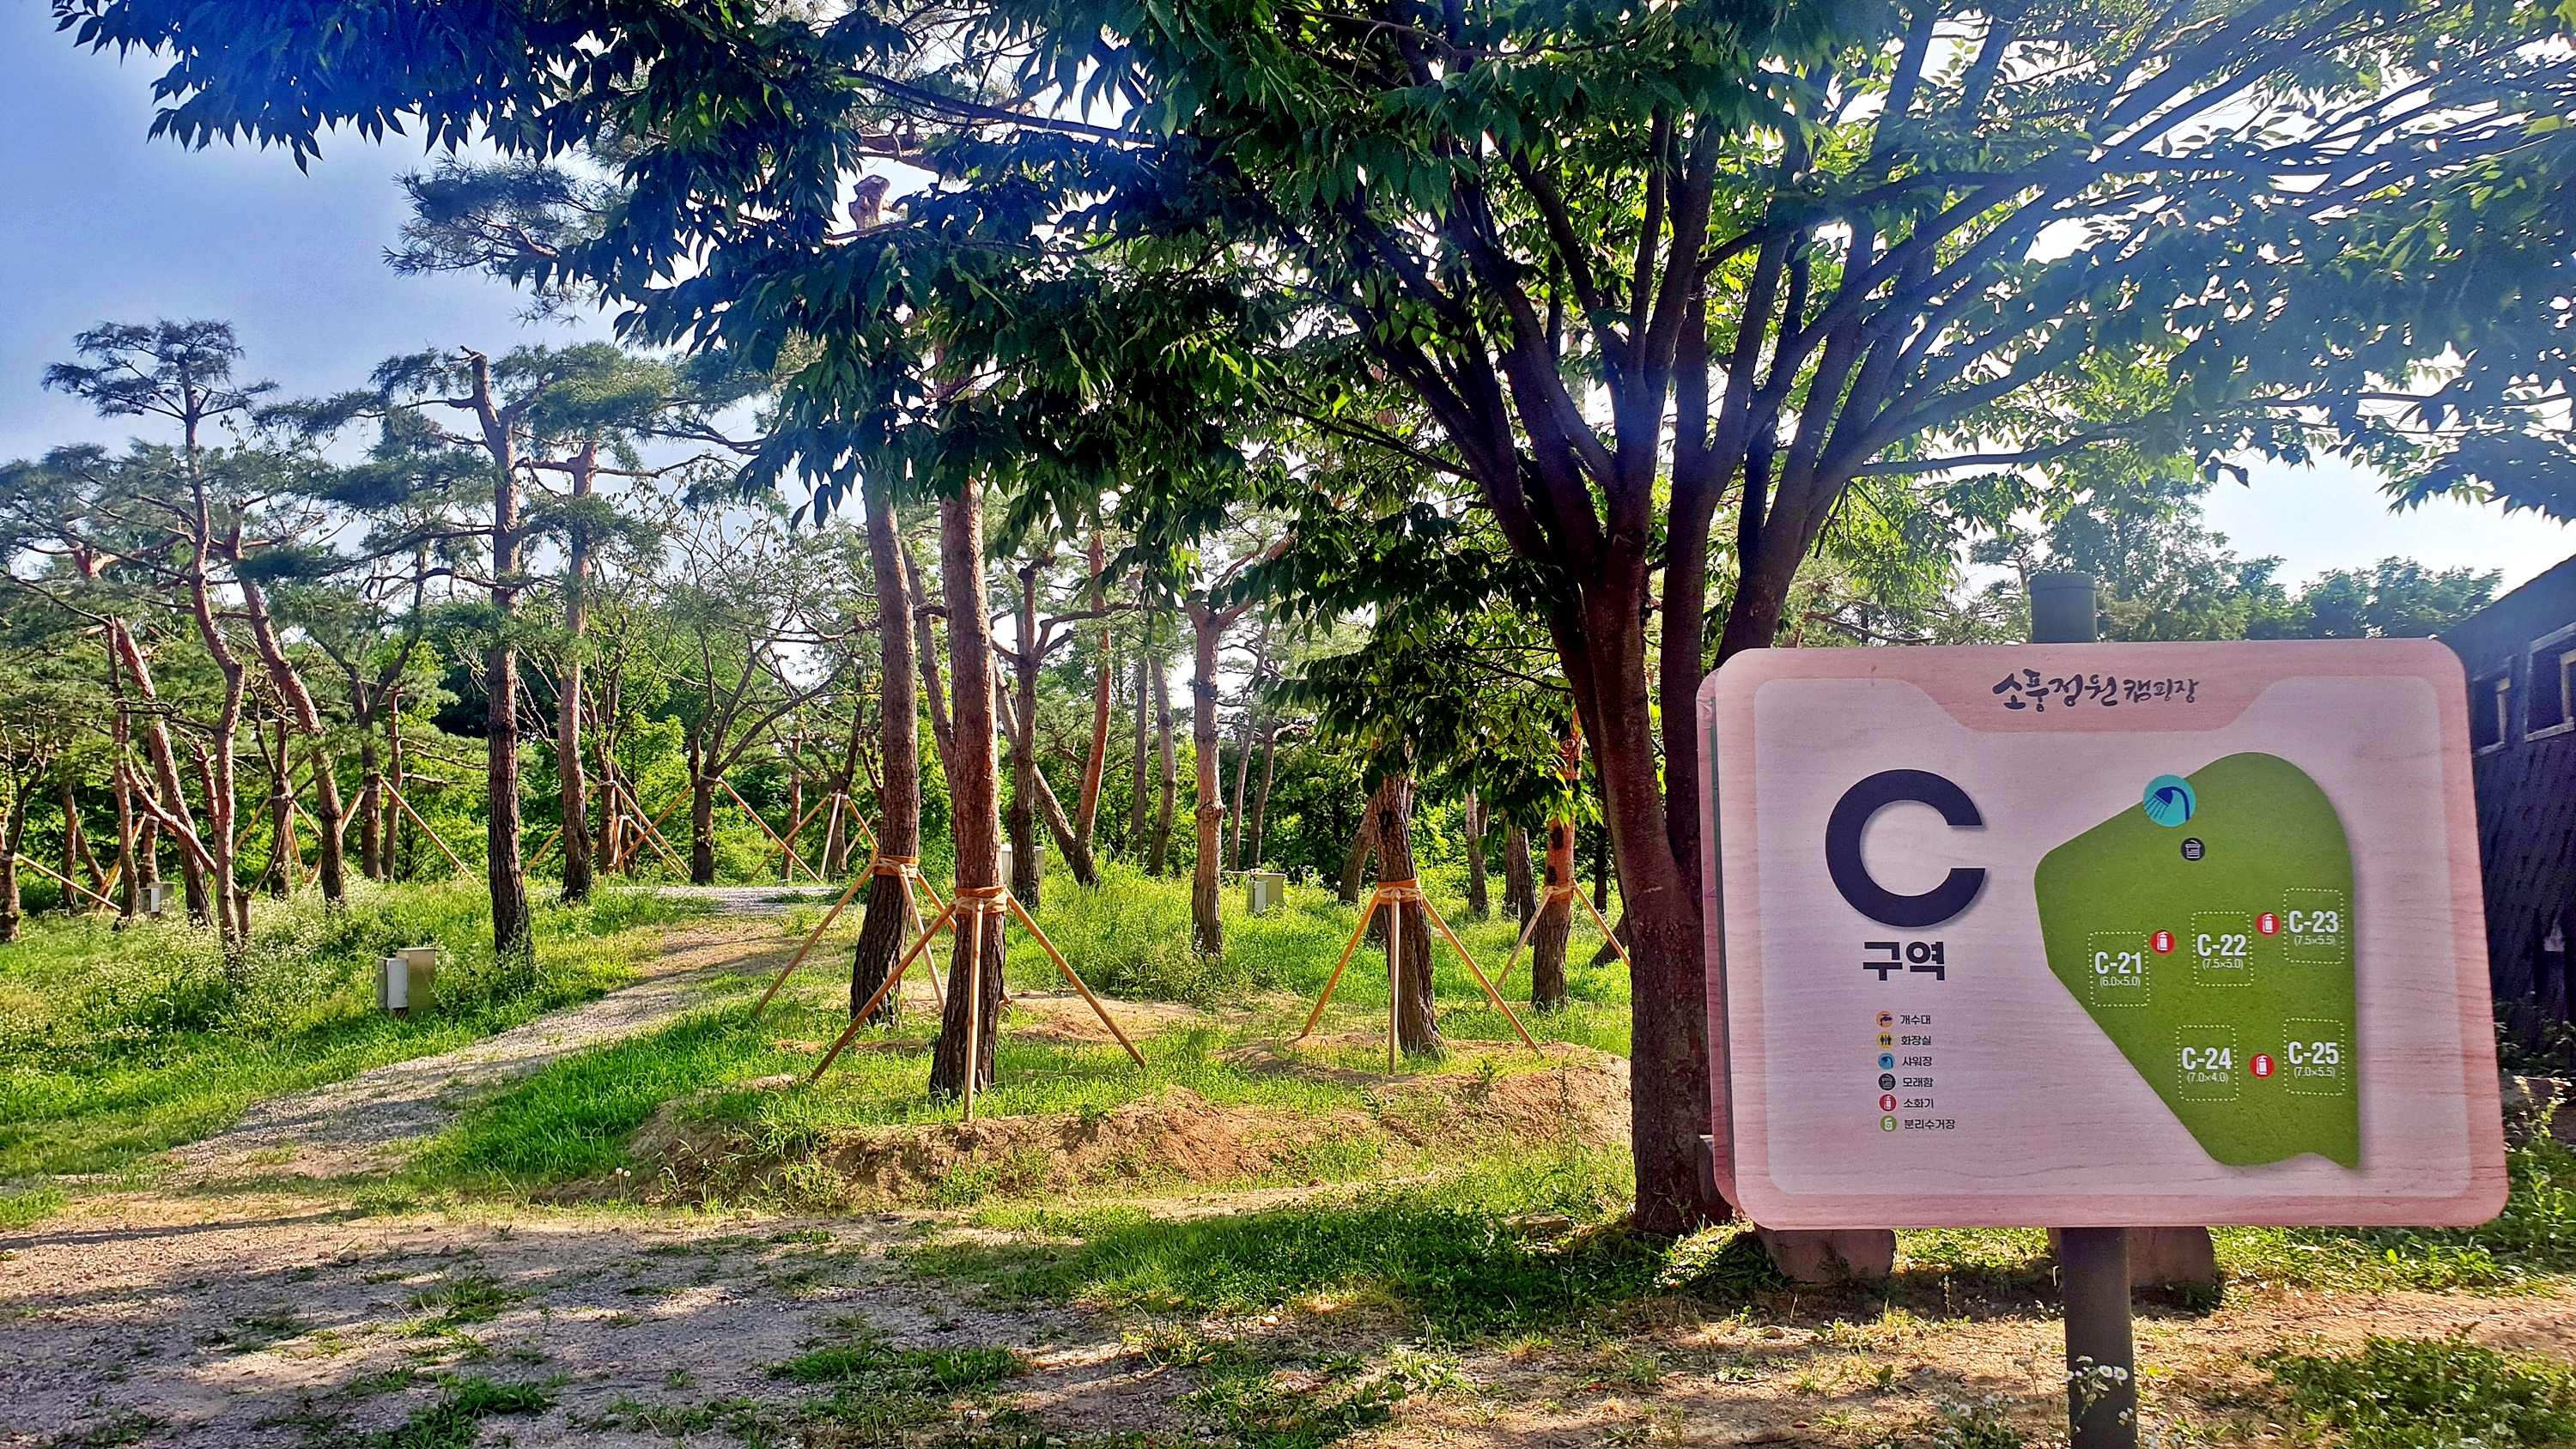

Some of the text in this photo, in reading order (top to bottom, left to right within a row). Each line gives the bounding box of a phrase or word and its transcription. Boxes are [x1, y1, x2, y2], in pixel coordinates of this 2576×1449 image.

[1992, 669, 2199, 712] 소풍정원 캠핑장
[1825, 768, 1986, 928] C
[2288, 910, 2339, 933] C-23
[2196, 933, 2247, 957] C-22
[1862, 941, 1946, 981] 구역
[2094, 951, 2142, 974] C-21
[1899, 1015, 1931, 1025] 개수대
[1900, 1035, 1931, 1046] 화장실
[1902, 1057, 1932, 1066] 샤워장
[2182, 1046, 2233, 1070] C-24
[2287, 1040, 2339, 1065] C-25
[1903, 1077, 1933, 1088] 모래함
[1903, 1098, 1934, 1108] 소화기
[1904, 1119, 1955, 1130] 분리수거장
